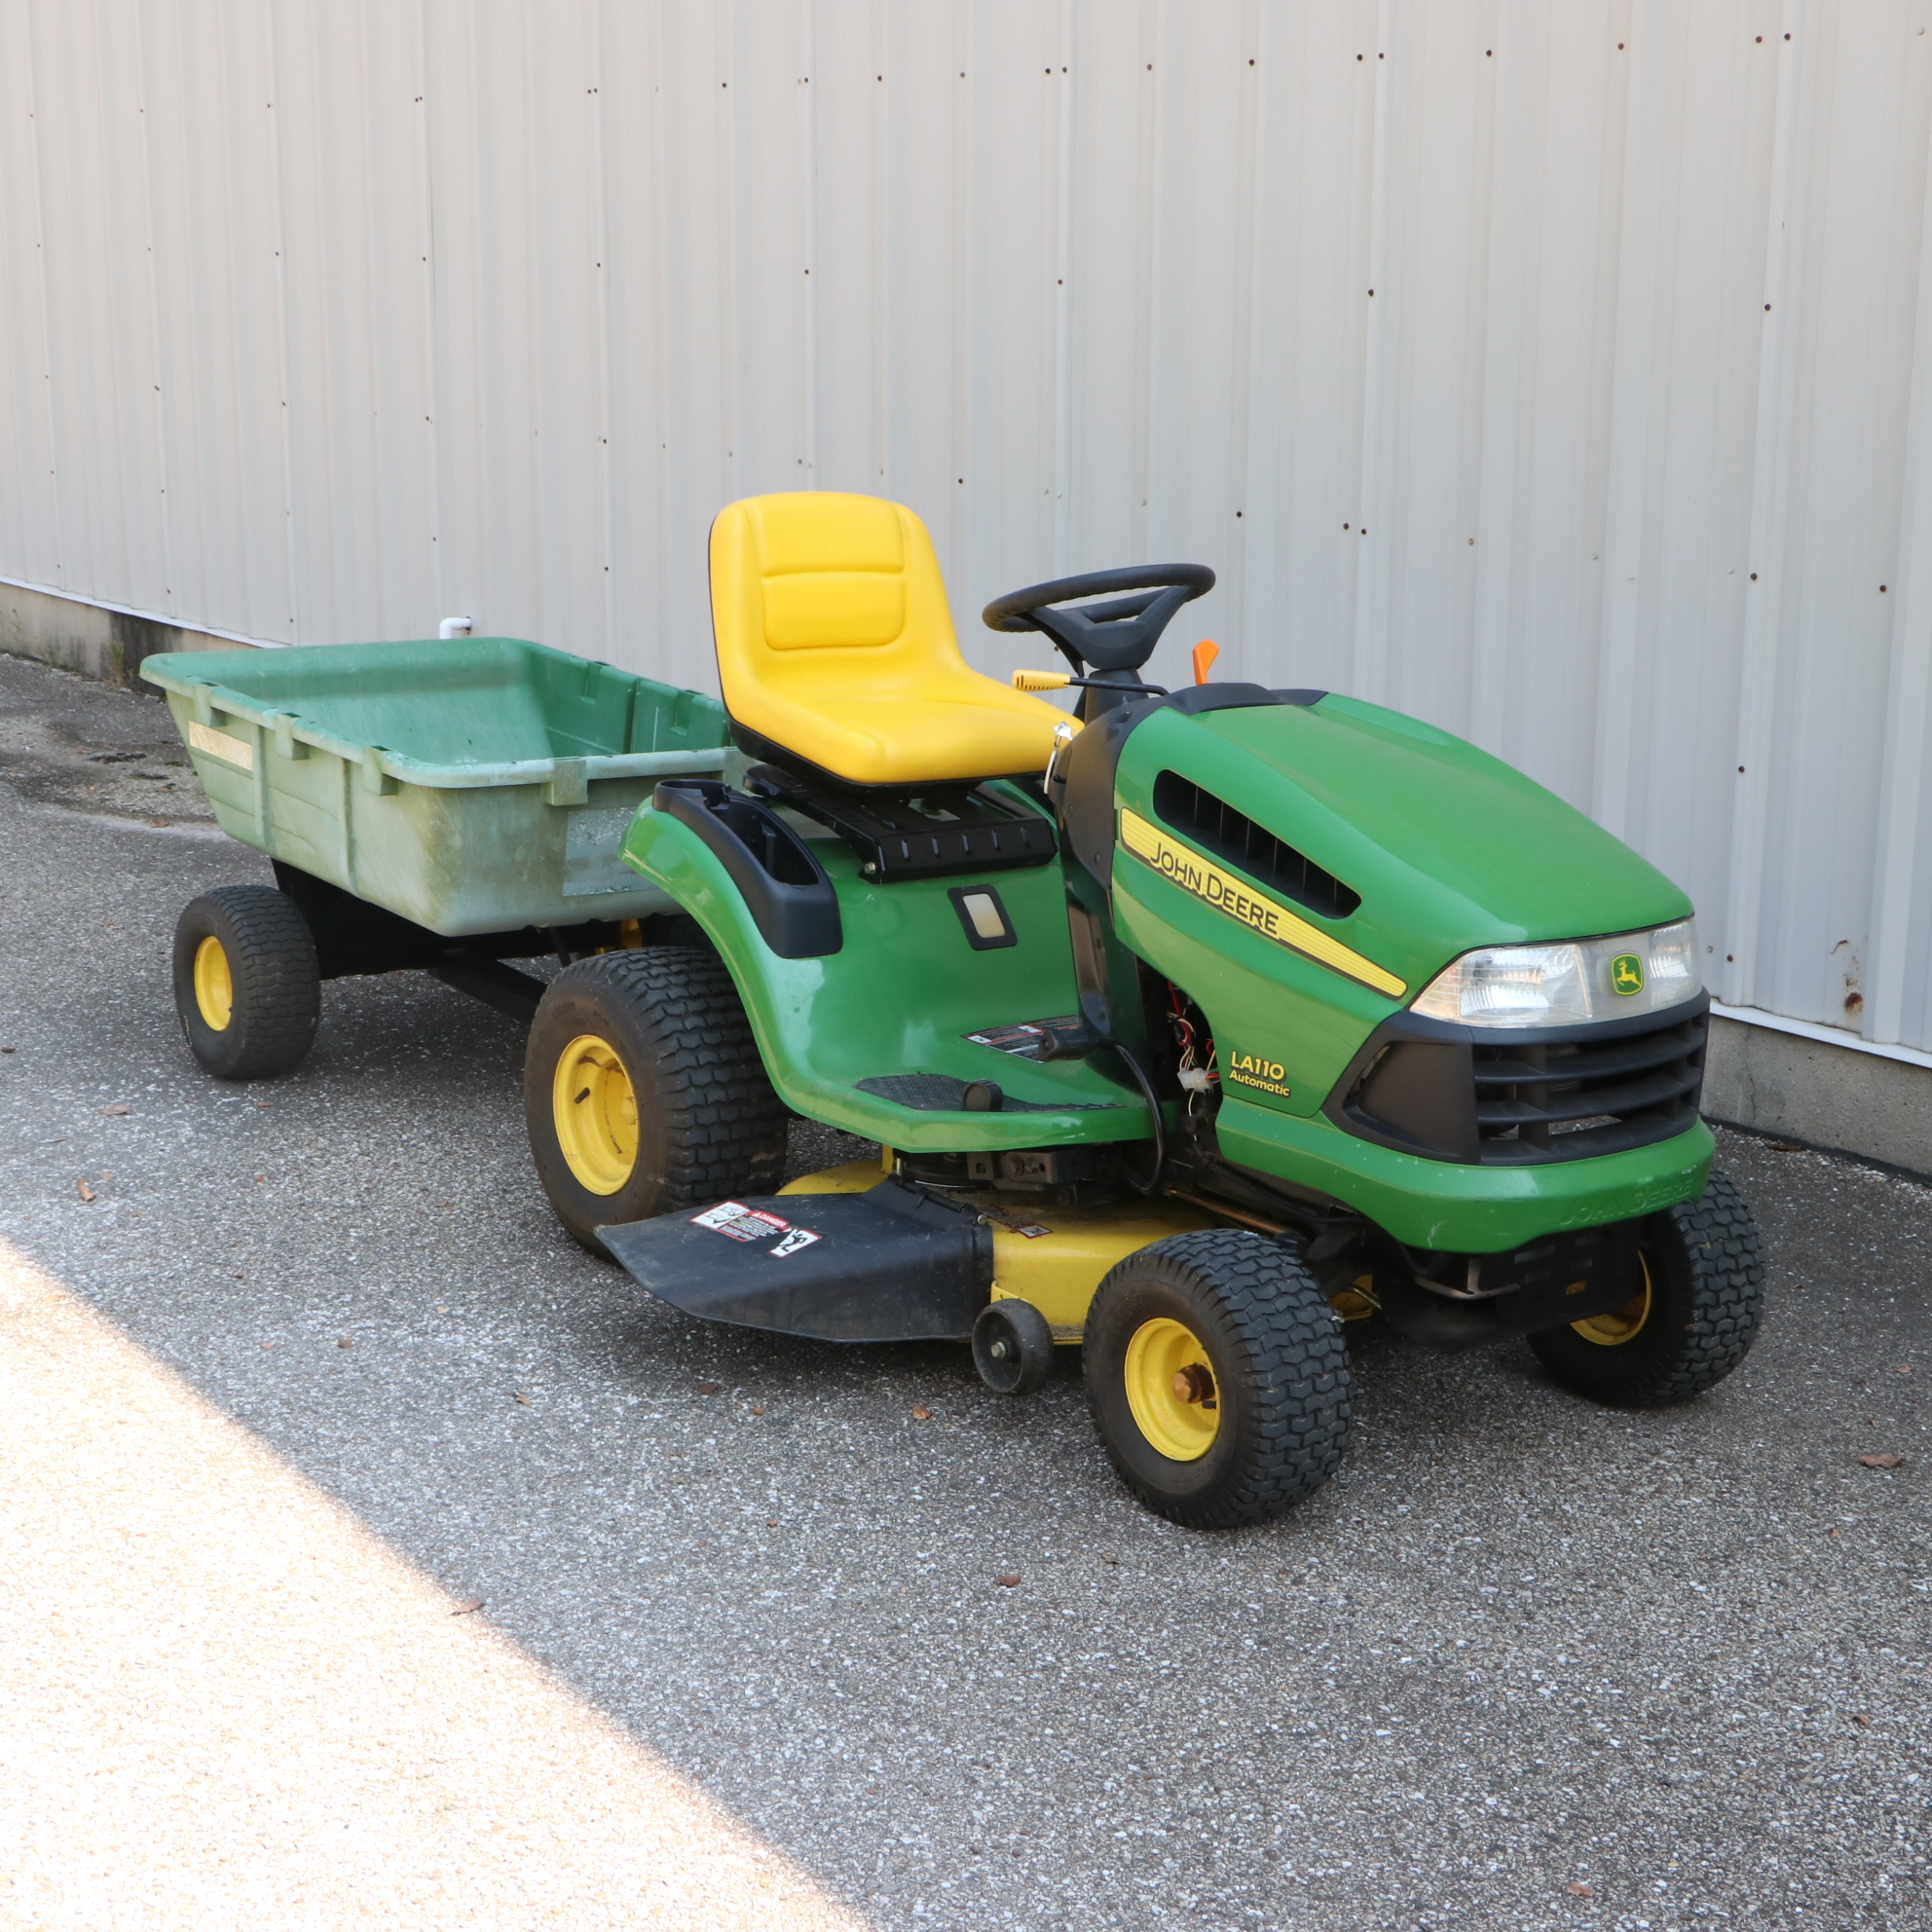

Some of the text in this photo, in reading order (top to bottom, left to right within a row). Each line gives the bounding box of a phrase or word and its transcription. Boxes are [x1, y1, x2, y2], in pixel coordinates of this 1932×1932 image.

[1150, 842, 1280, 936] JOHN DEERE
[1231, 1051, 1284, 1080] LA110
[1229, 1070, 1290, 1096] Automatic
[1558, 1179, 1694, 1226] JOHN DEERE
[760, 1213, 787, 1228] DANGER
